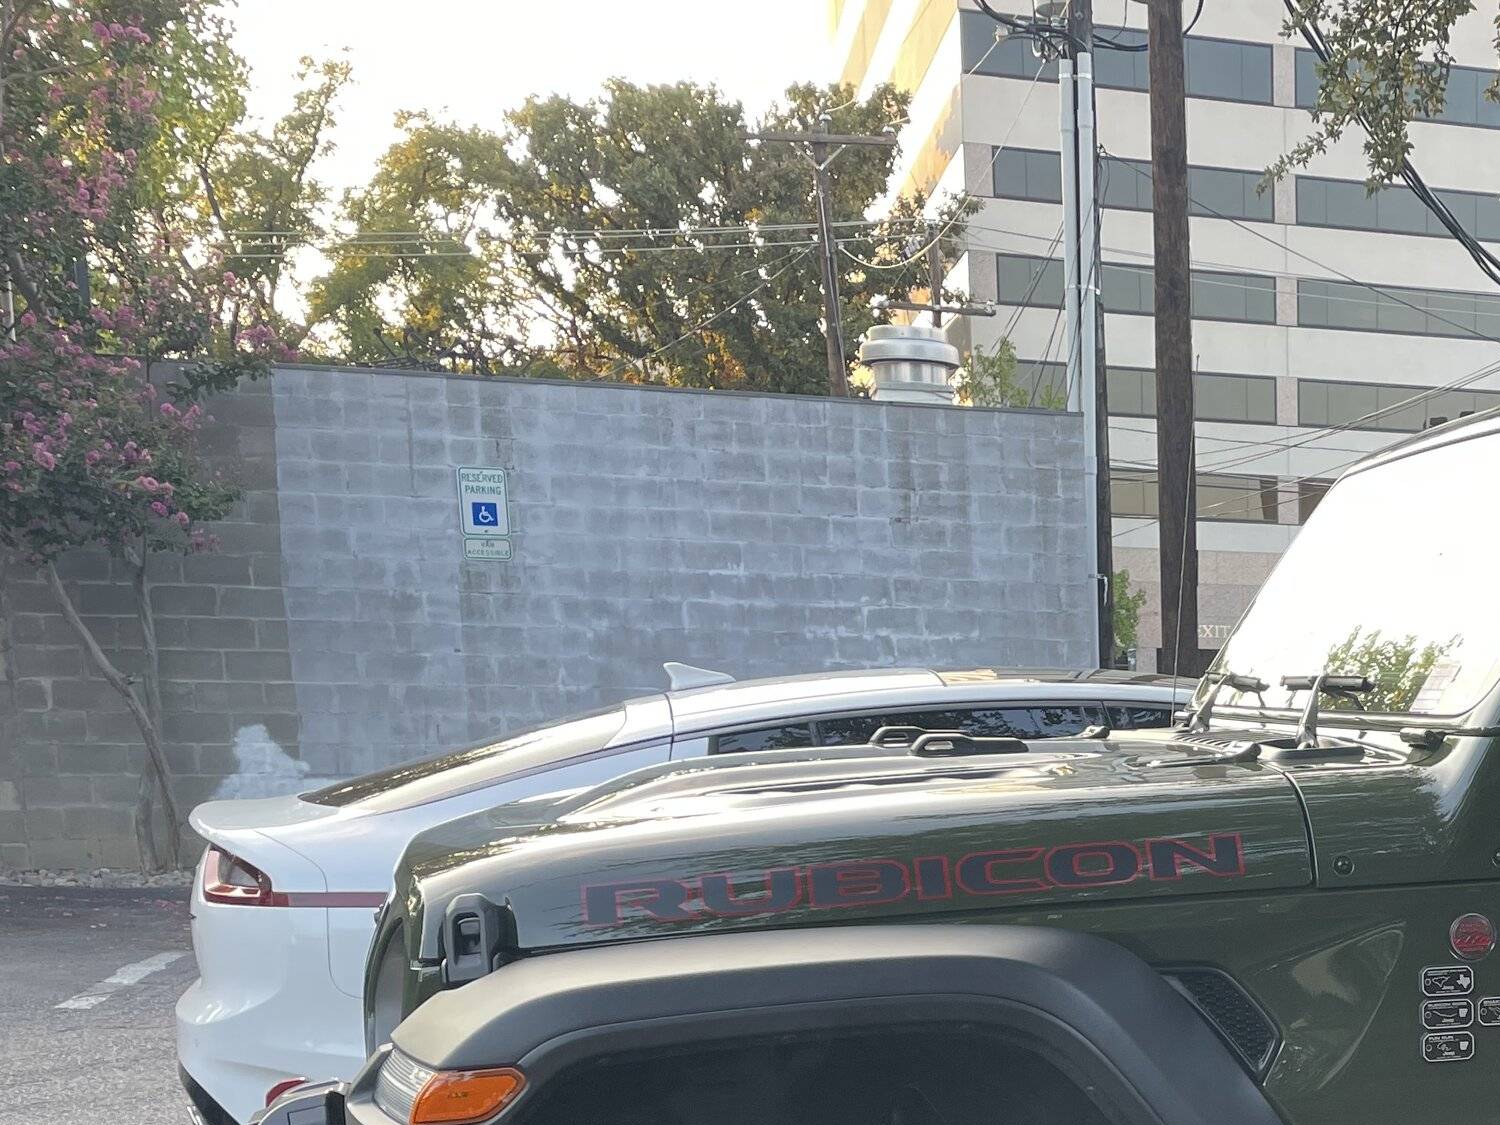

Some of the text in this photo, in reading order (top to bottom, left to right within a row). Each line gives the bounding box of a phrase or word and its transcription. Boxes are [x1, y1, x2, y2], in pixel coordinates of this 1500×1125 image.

[461, 473, 503, 484] RESERVED
[464, 484, 502, 496] PARKING
[580, 833, 1246, 928] RUBICON
